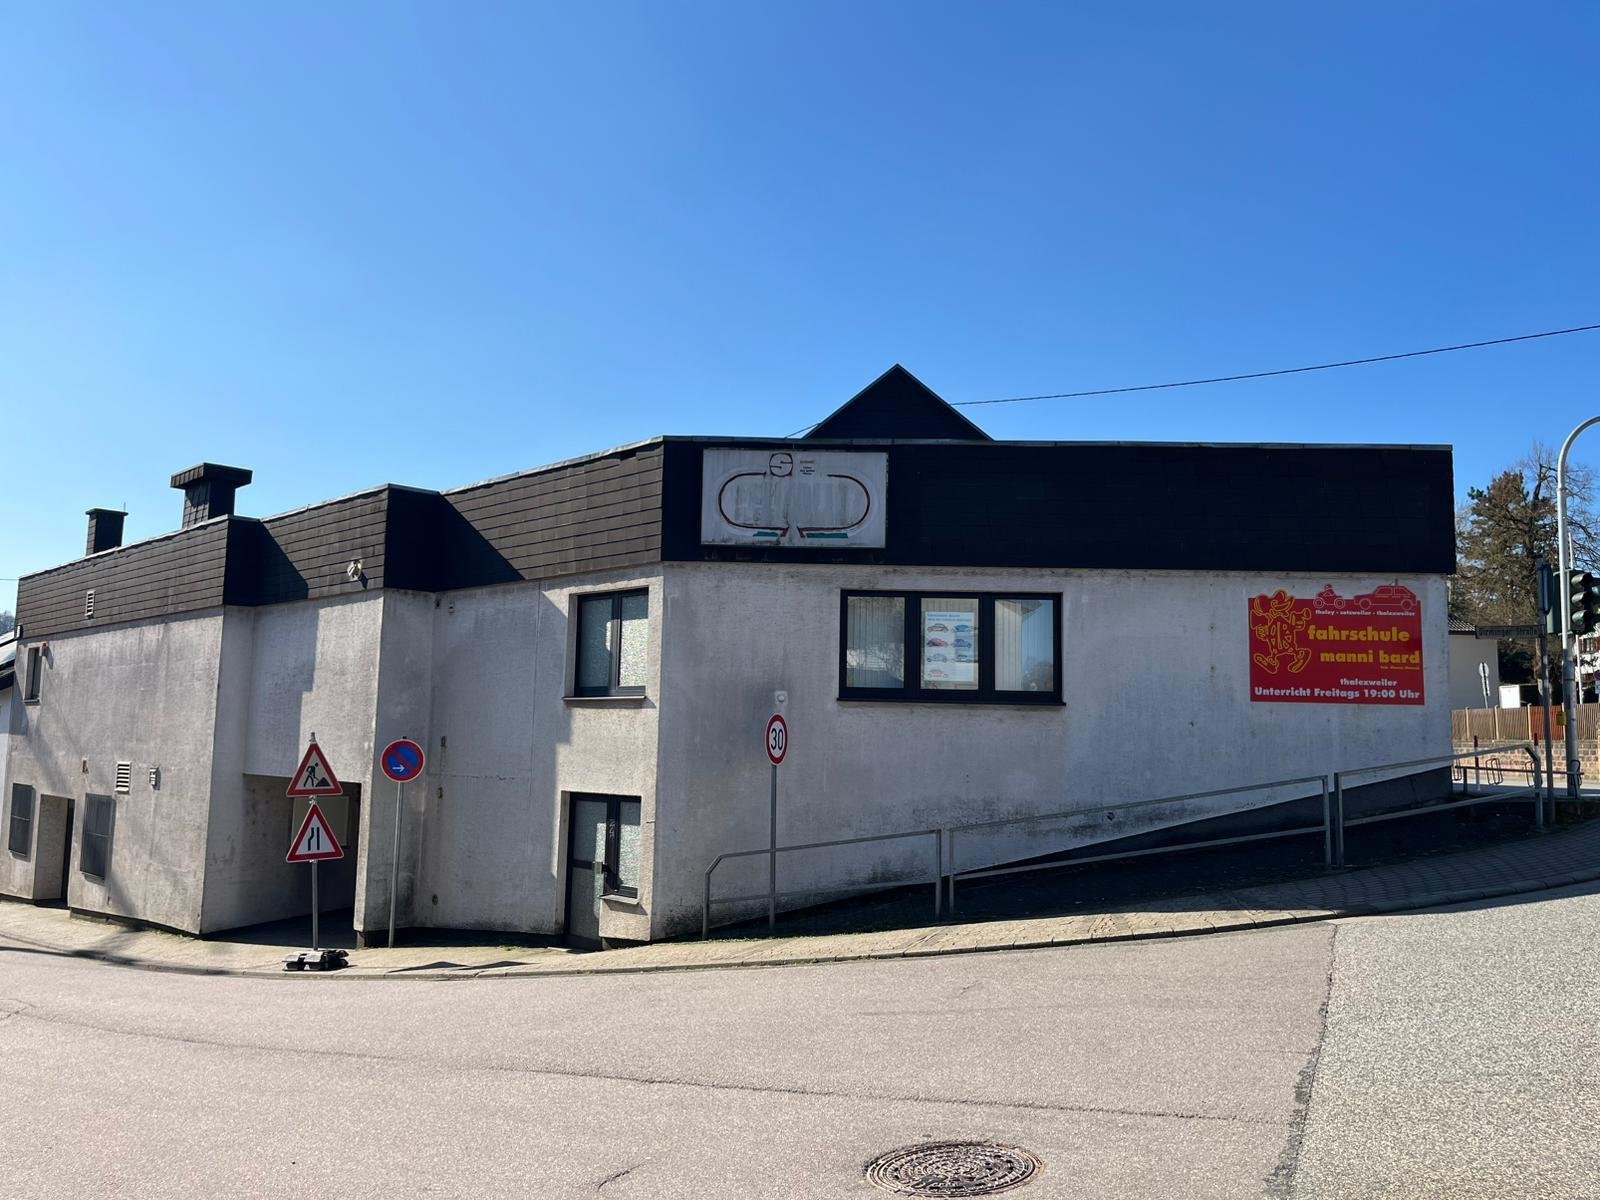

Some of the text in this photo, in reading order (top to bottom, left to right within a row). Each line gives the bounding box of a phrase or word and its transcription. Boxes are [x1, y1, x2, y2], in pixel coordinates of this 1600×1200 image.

[1307, 624, 1410, 641] fahrschule
[1320, 650, 1420, 664] manni bard
[1340, 678, 1398, 687] thalexweiler
[1254, 686, 1420, 699] Unterricht Freitags 19:00 Uhr
[770, 727, 784, 751] 30
